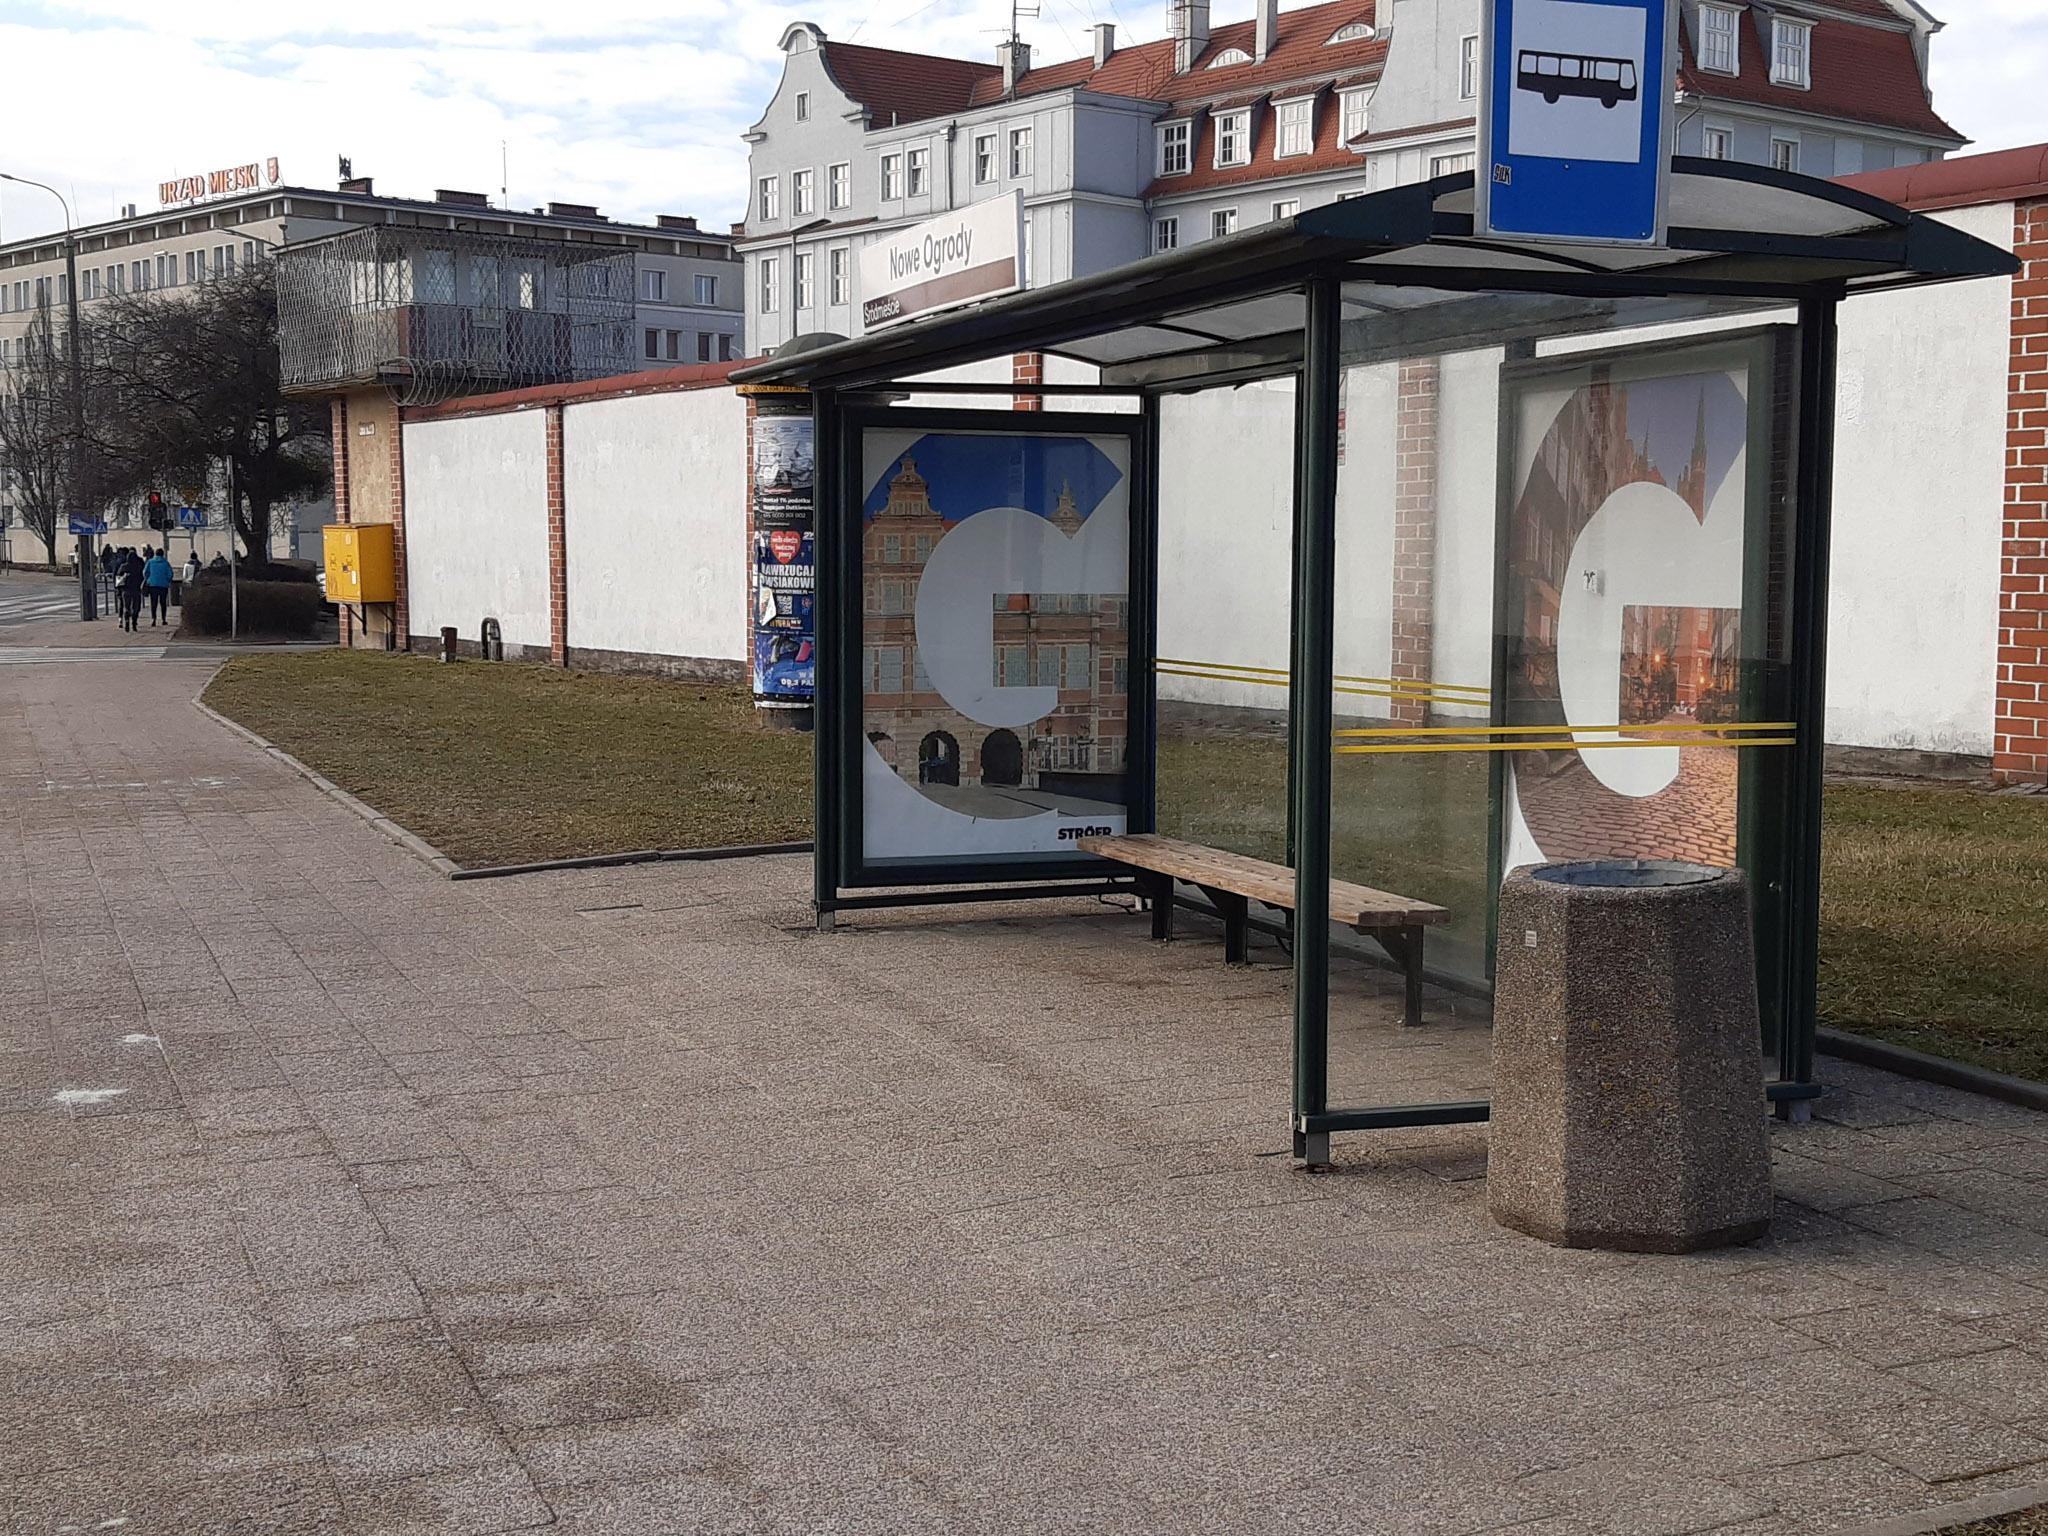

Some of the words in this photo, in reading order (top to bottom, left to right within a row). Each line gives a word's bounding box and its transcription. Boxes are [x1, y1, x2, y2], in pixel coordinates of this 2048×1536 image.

[208, 163, 259, 195] MIEJSKI
[890, 246, 920, 281] Nowe
[923, 222, 973, 275] Ogrody
[1058, 825, 1112, 841] STRÖER
